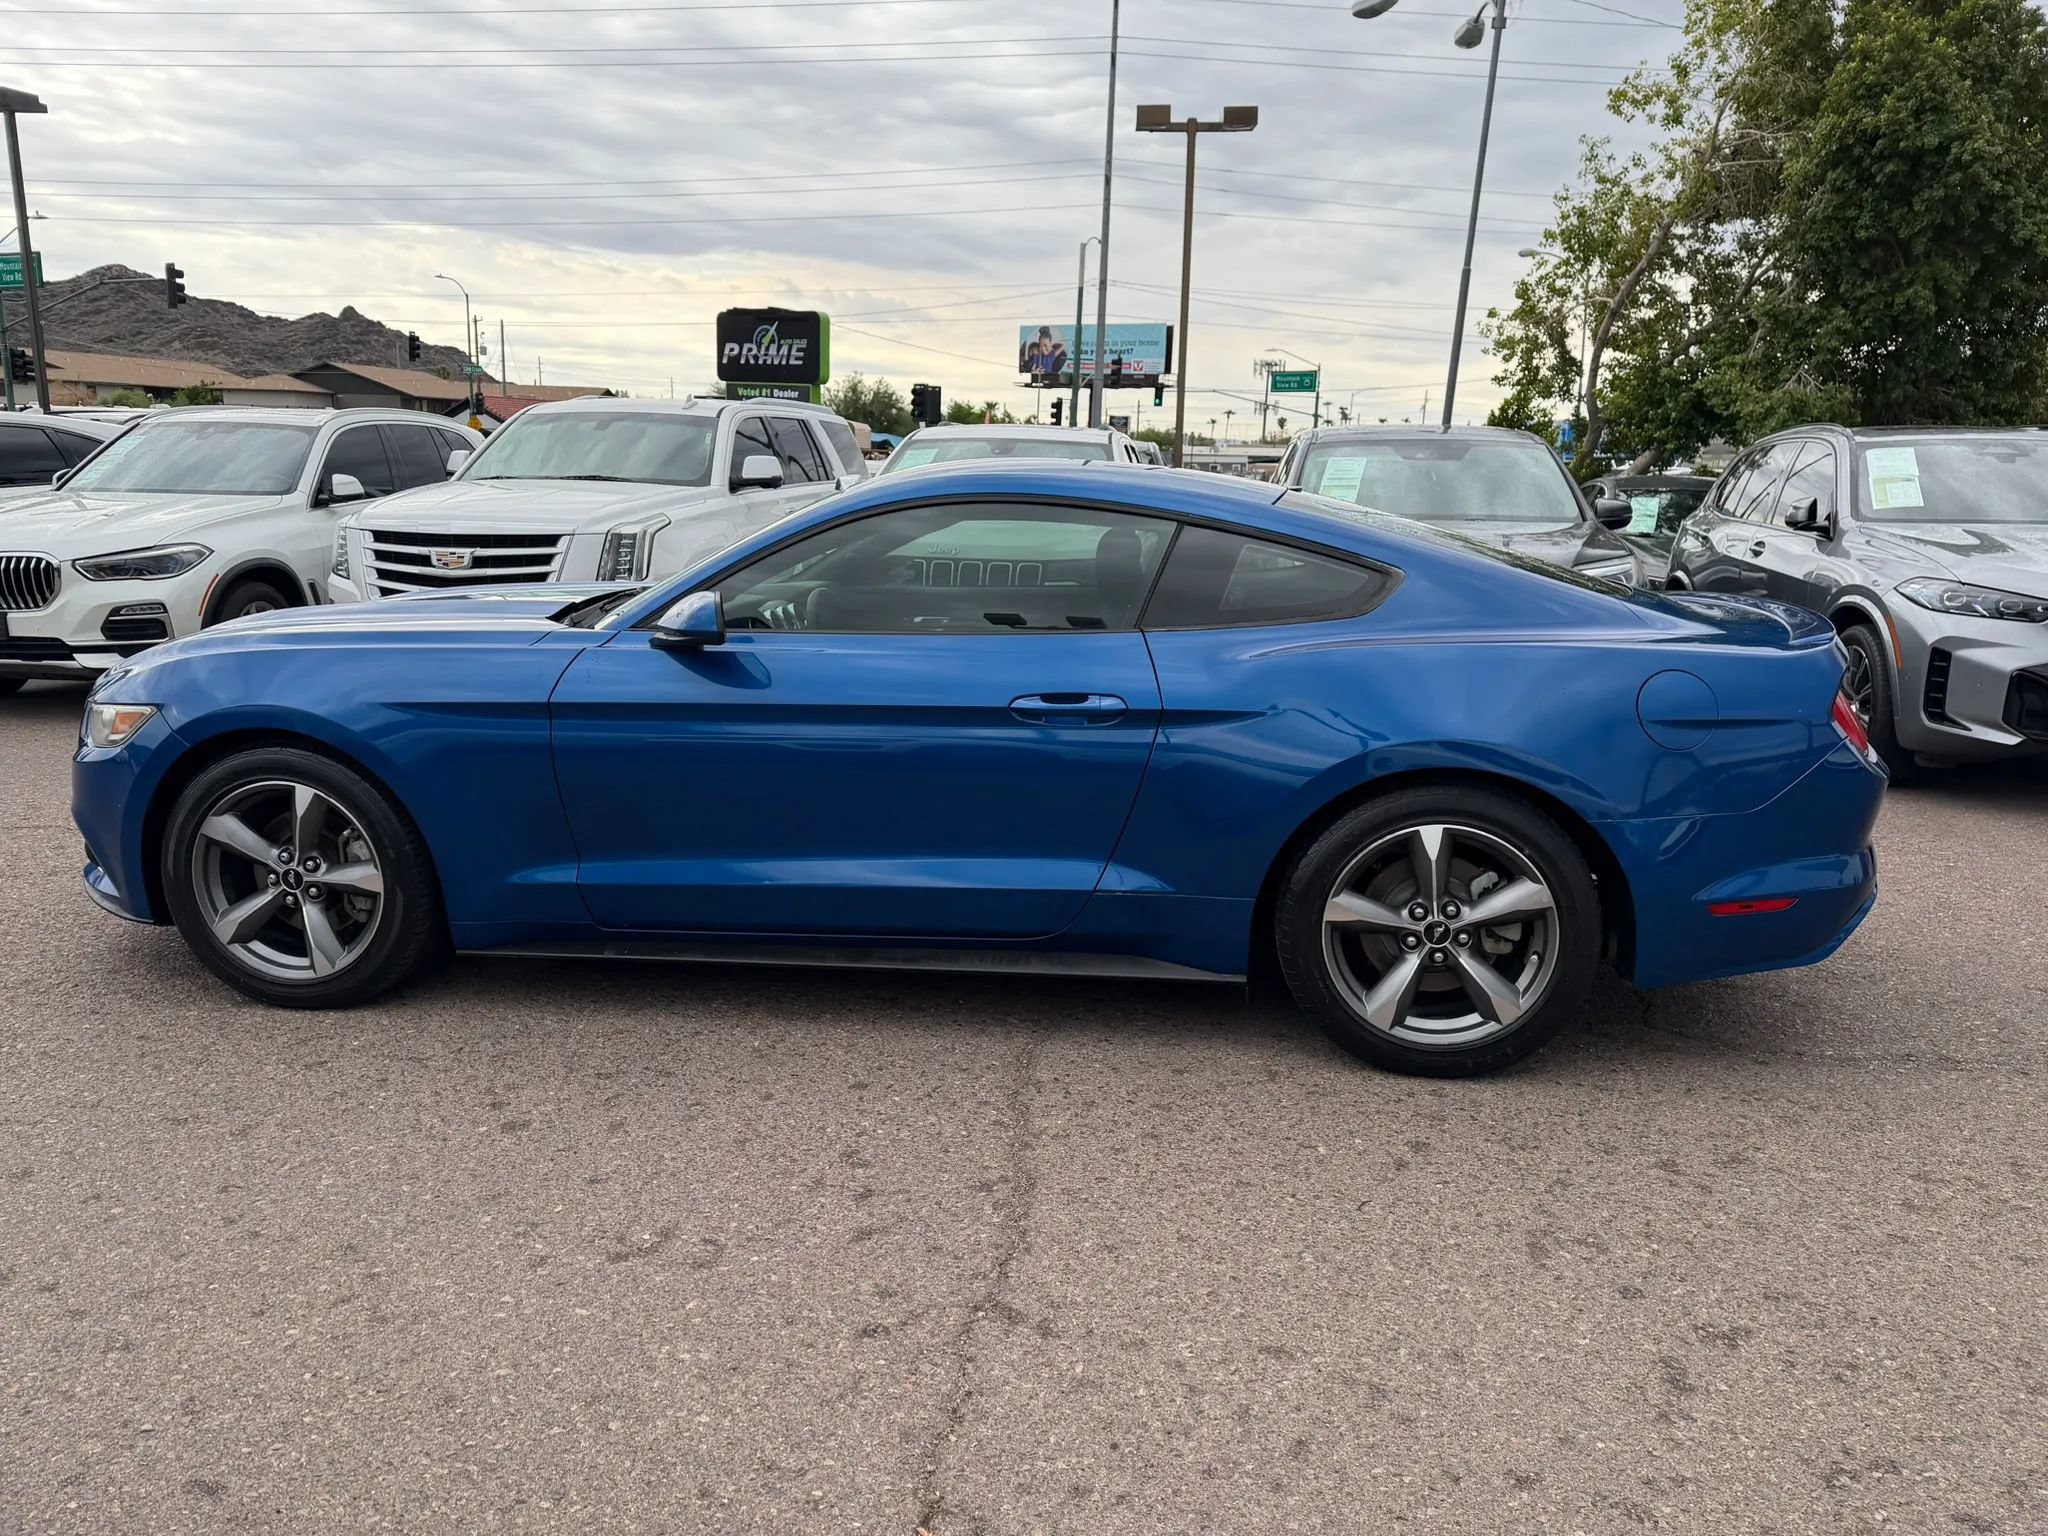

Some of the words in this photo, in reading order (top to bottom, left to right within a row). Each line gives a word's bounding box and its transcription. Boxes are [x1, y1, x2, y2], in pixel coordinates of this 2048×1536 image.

[2, 271, 14, 281] View
[722, 342, 807, 365] PRIME
[737, 387, 760, 397] Voted
[773, 388, 799, 399] Dealer
[928, 544, 960, 557] Jeep
